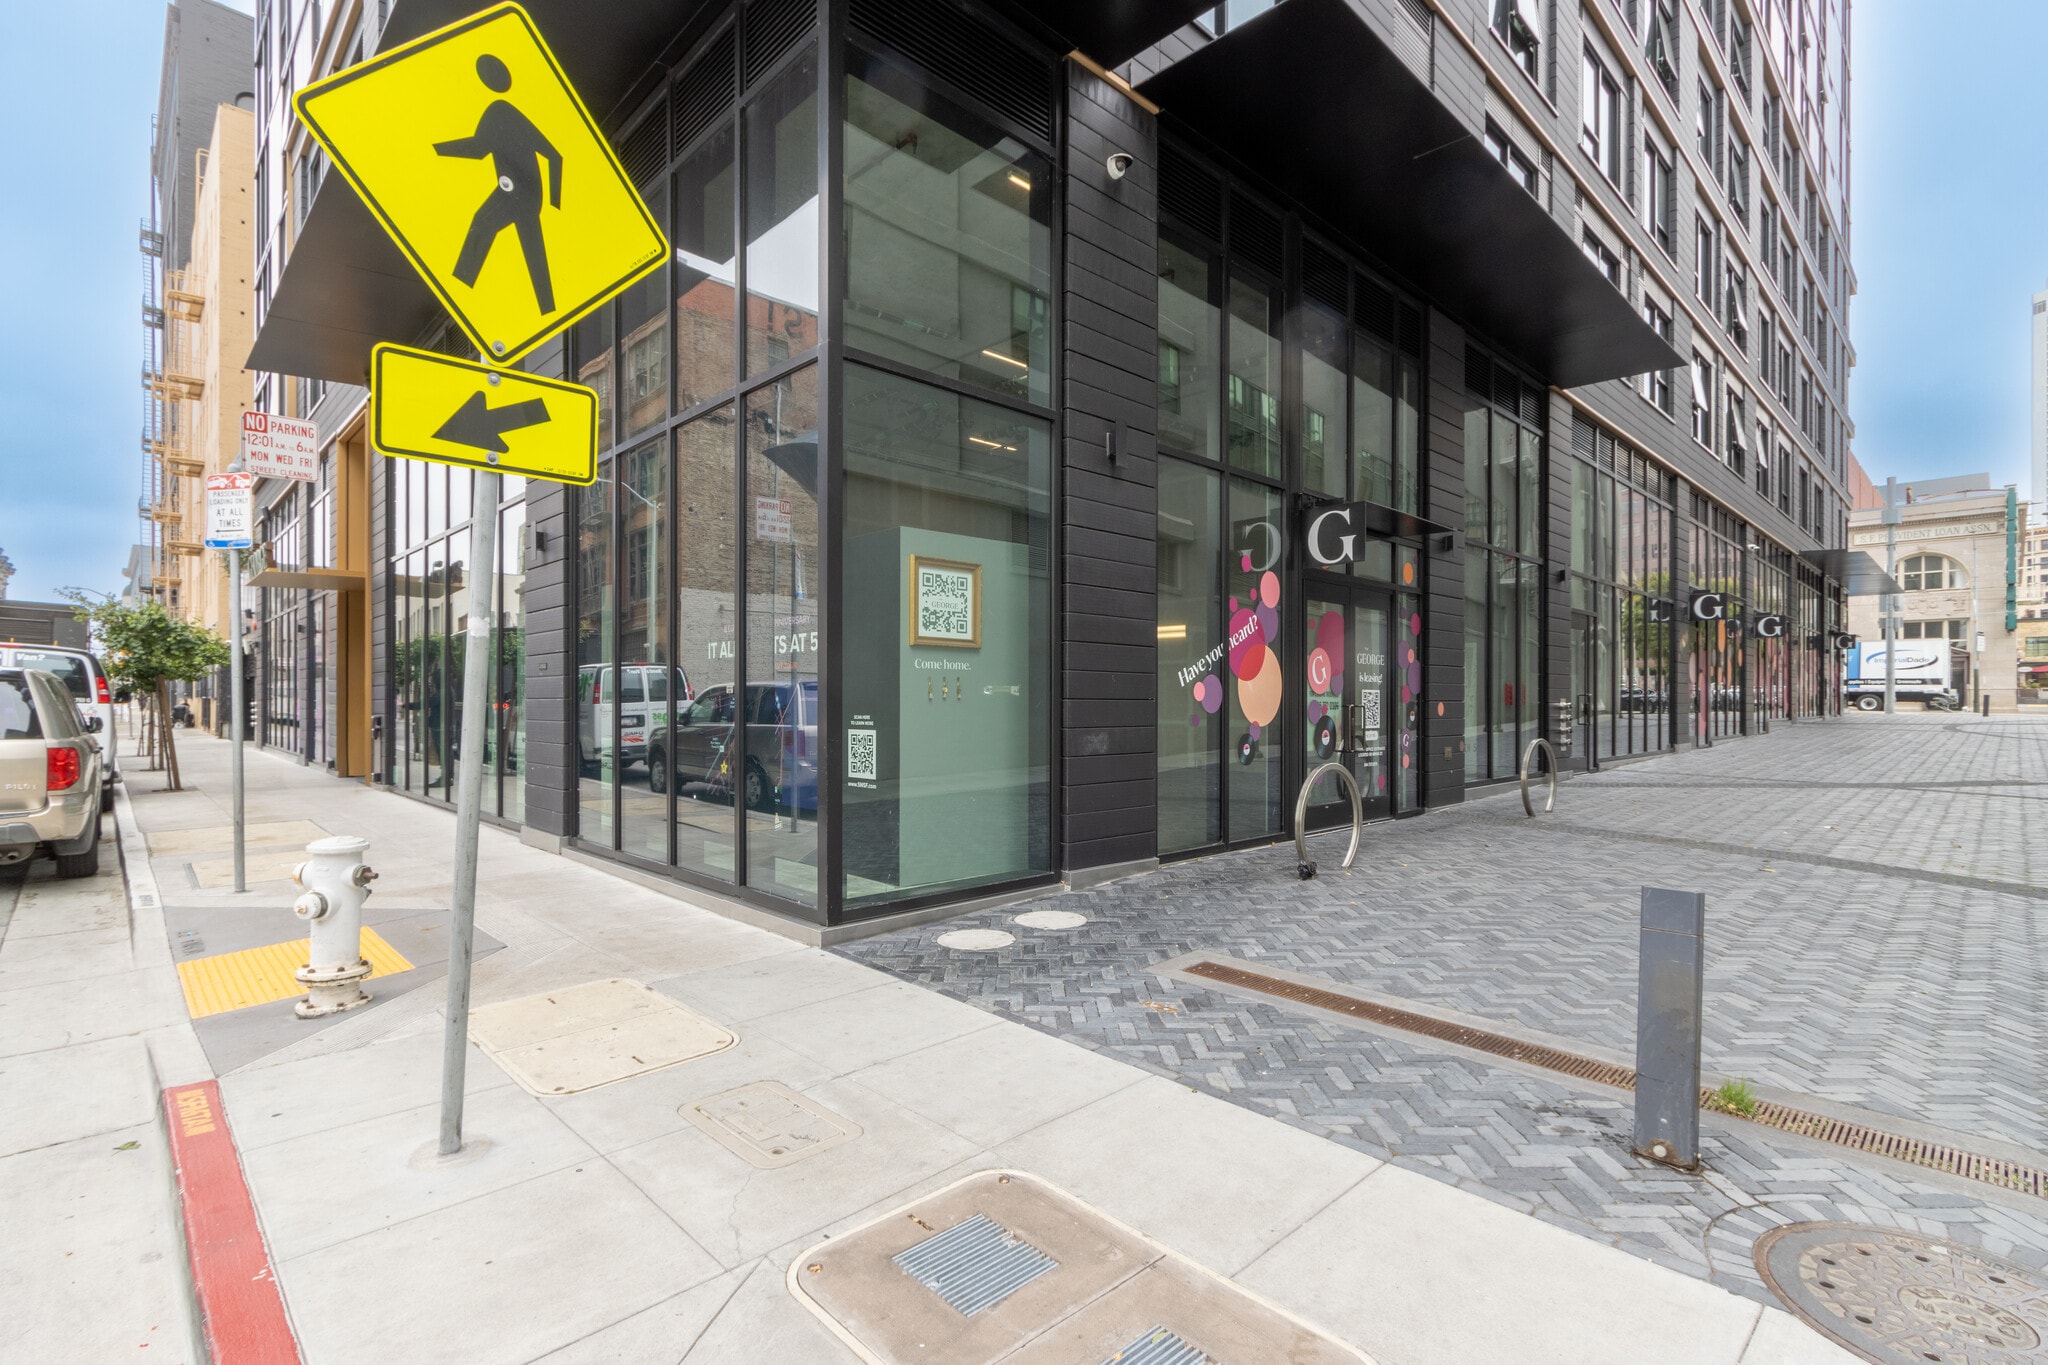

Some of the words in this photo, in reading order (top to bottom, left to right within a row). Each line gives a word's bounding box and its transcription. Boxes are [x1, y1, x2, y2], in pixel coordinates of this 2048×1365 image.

[246, 413, 267, 432] NO
[270, 421, 314, 439] PARKING
[247, 433, 273, 448] 12:01
[296, 441, 303, 453] 6
[250, 450, 269, 462] MON
[276, 454, 293, 465] WED
[300, 458, 312, 468] FRI
[250, 465, 276, 475] STREET
[281, 470, 313, 480] CLEANING
[216, 508, 226, 516] AT
[229, 508, 243, 516] ALL
[219, 519, 241, 528] TIMES
[1307, 508, 1357, 565] G
[1878, 529, 1932, 542] PRVIDENT
[1935, 525, 1960, 536] LOAN
[931, 600, 959, 610] GEORGE
[1693, 594, 1724, 620] G
[1757, 616, 1783, 637] G
[708, 642, 718, 659] IT
[790, 633, 807, 653] AT
[1835, 635, 1852, 650] G
[16, 653, 45, 661] Van?
[914, 658, 942, 669] Come
[943, 659, 971, 671] home.
[1356, 653, 1385, 666] GEORGE
[1177, 657, 1206, 687] Have
[1312, 655, 1327, 684] G
